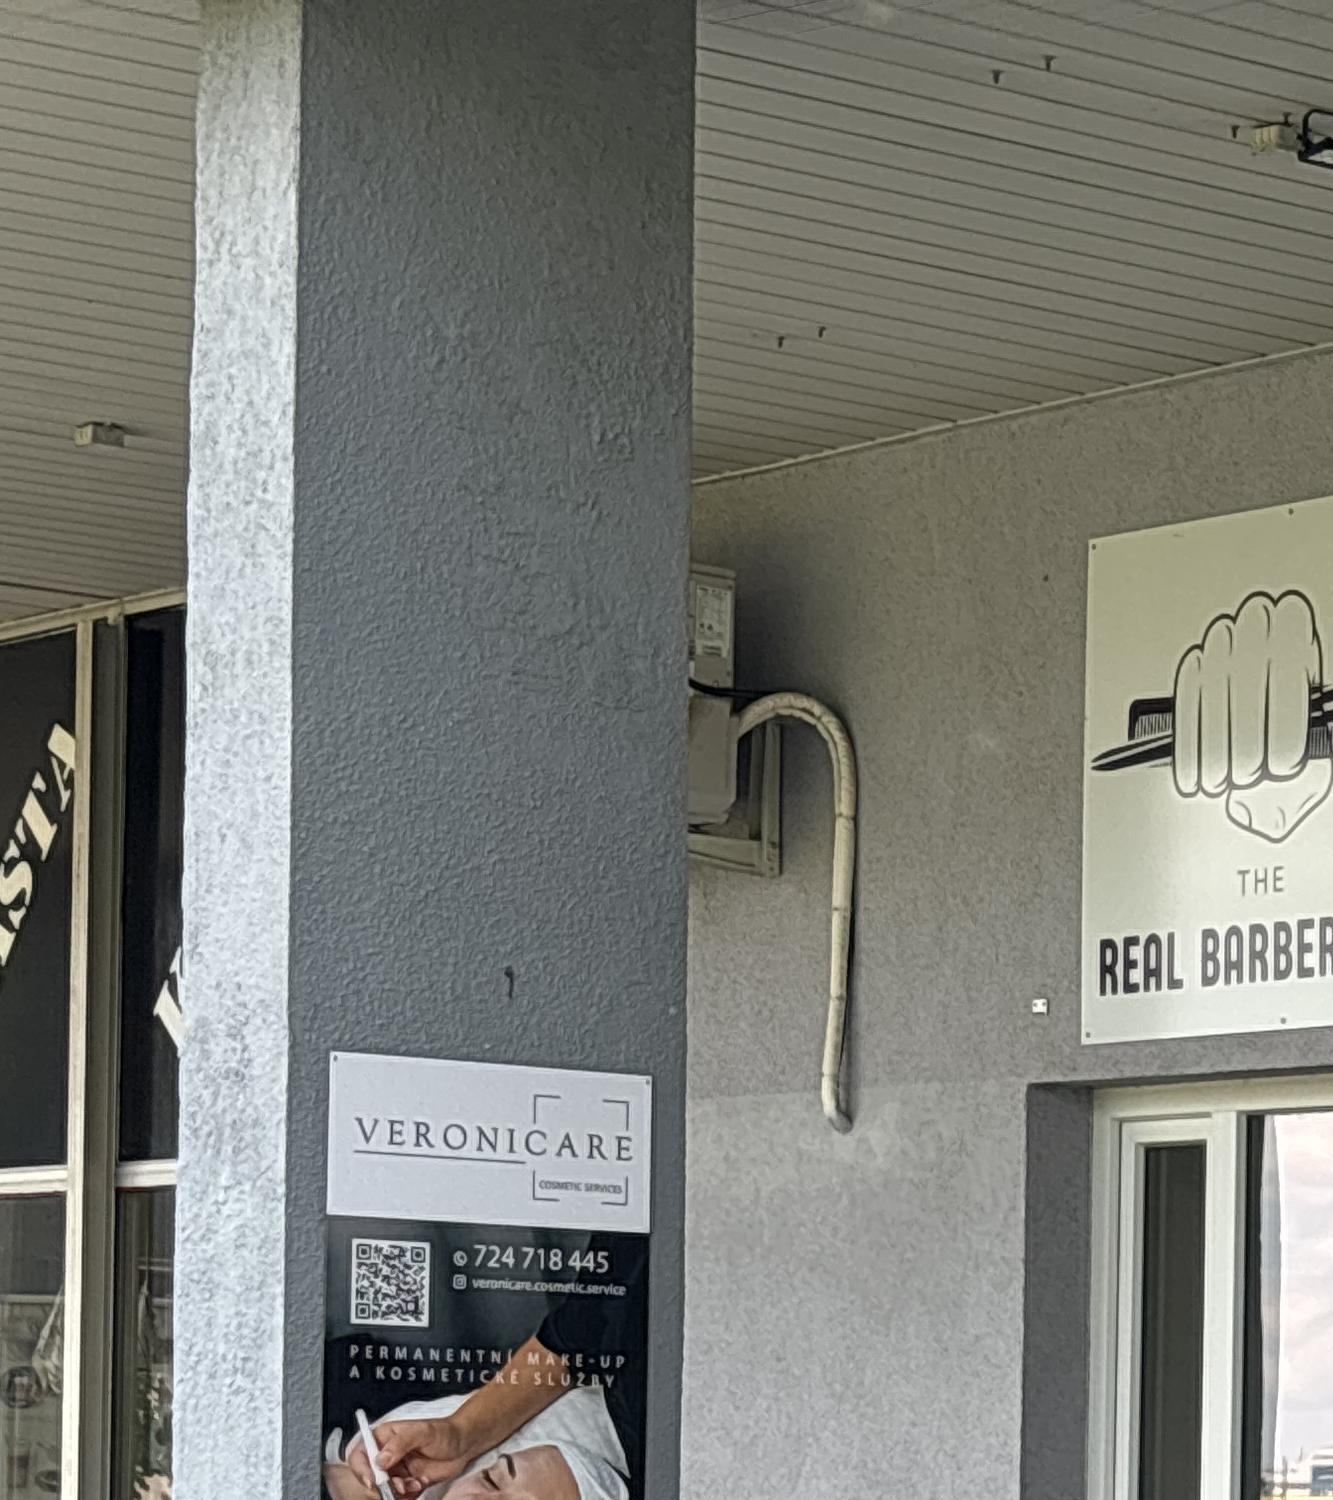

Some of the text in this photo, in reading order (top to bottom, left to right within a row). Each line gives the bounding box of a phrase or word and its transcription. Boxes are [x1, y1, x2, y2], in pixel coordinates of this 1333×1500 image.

[0, 723, 77, 967] STA
[1237, 866, 1285, 897] THE
[1100, 933, 1184, 996] REAL
[354, 1117, 634, 1162] VERONICARE
[473, 1245, 609, 1273] 724 718 445
[349, 1344, 626, 1370] PERMANENTNÍ MAKE-UP
[350, 1367, 615, 1389] A KOSMETICKÉ SLUŽBY
